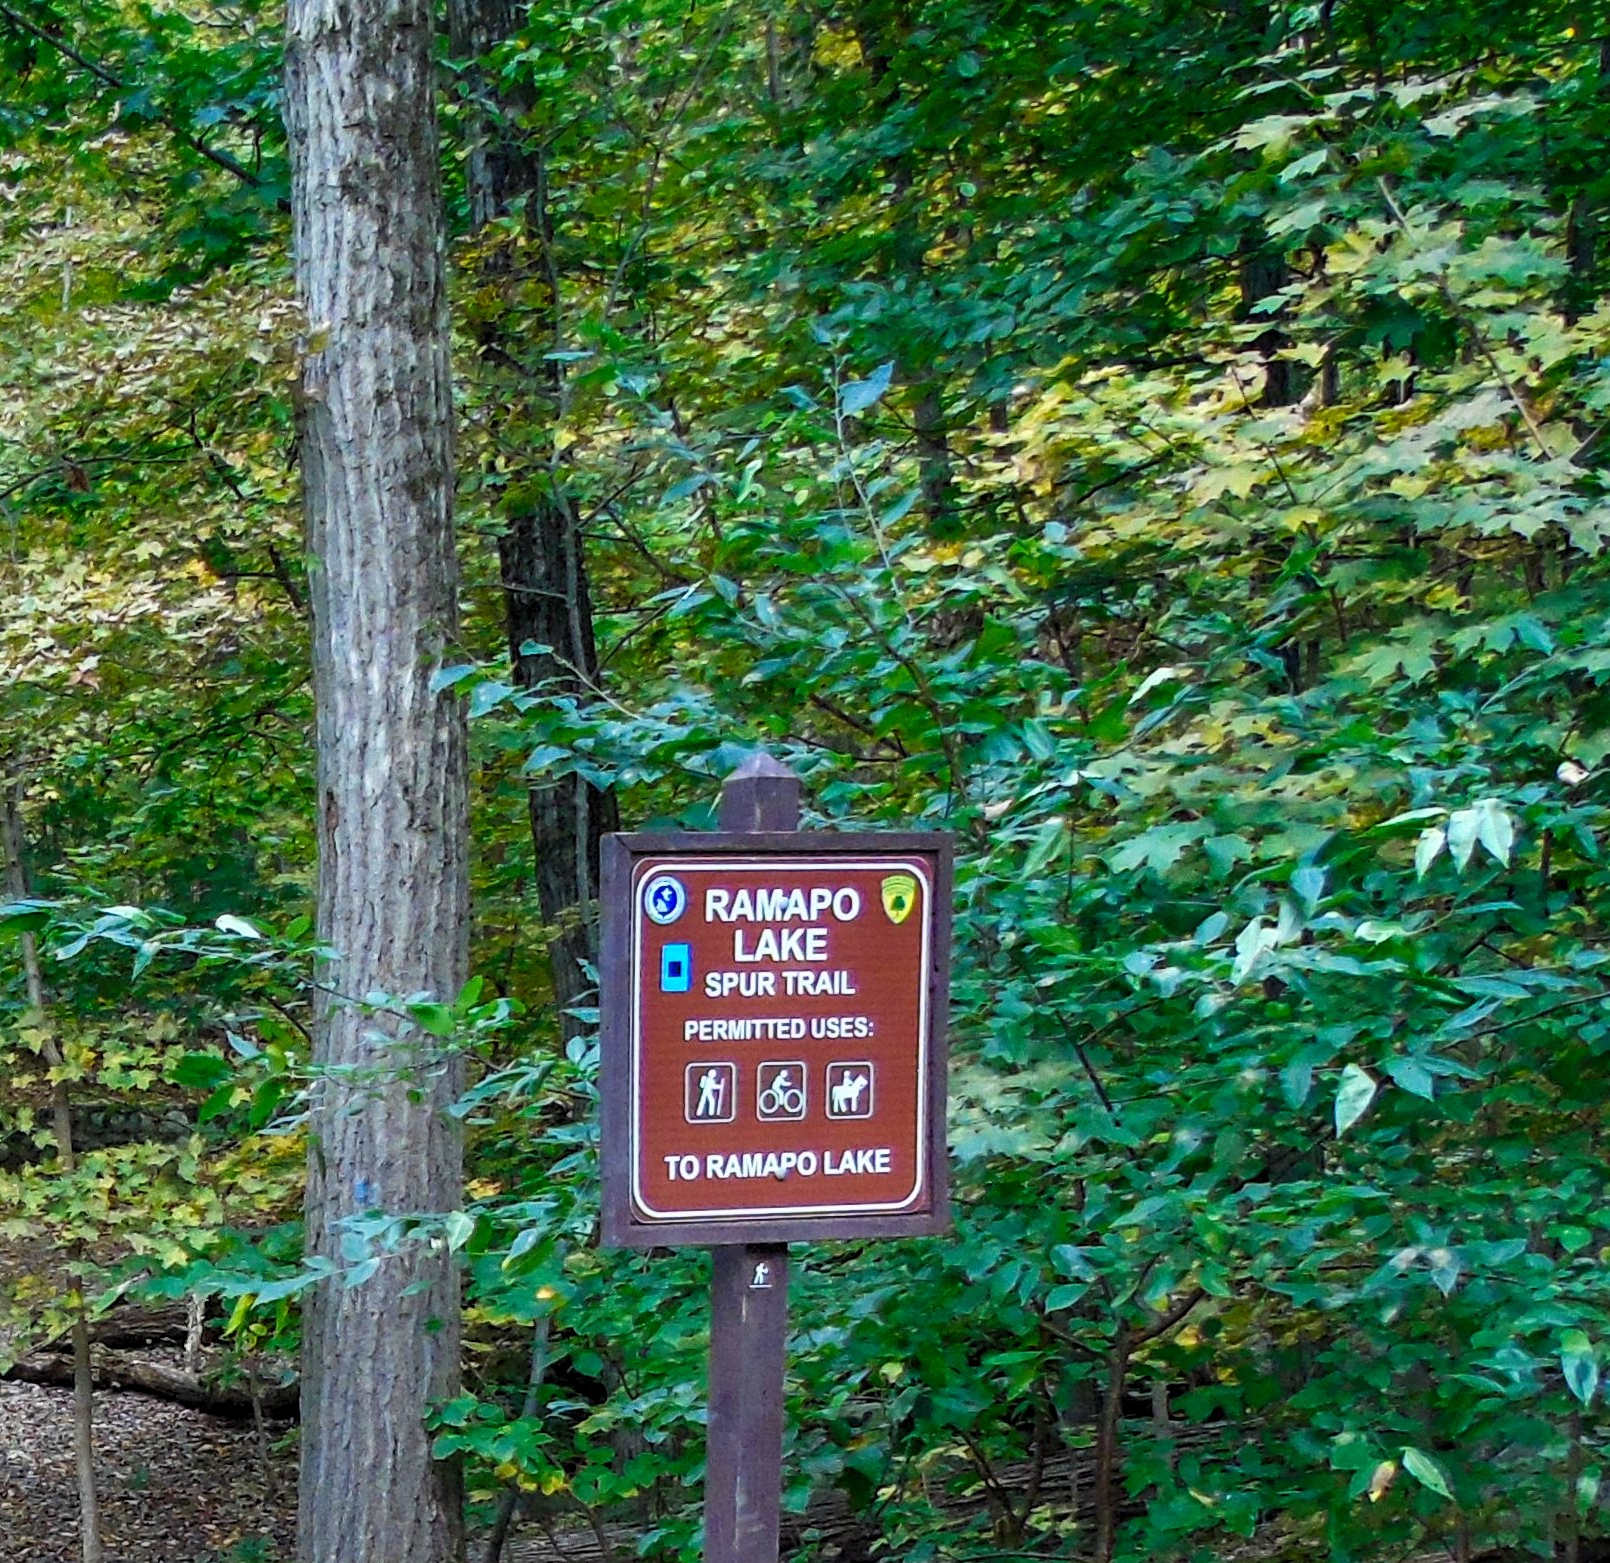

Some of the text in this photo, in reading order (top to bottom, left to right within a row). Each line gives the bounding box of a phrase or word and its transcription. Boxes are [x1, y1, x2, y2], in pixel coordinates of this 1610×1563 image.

[704, 887, 861, 923] RAMAPO
[734, 927, 829, 963] LAKE
[704, 969, 857, 998] SPUR TRAIL
[684, 1016, 875, 1042] PERMITTED USES:
[664, 1148, 892, 1181] TO RAMAPO LAKE
